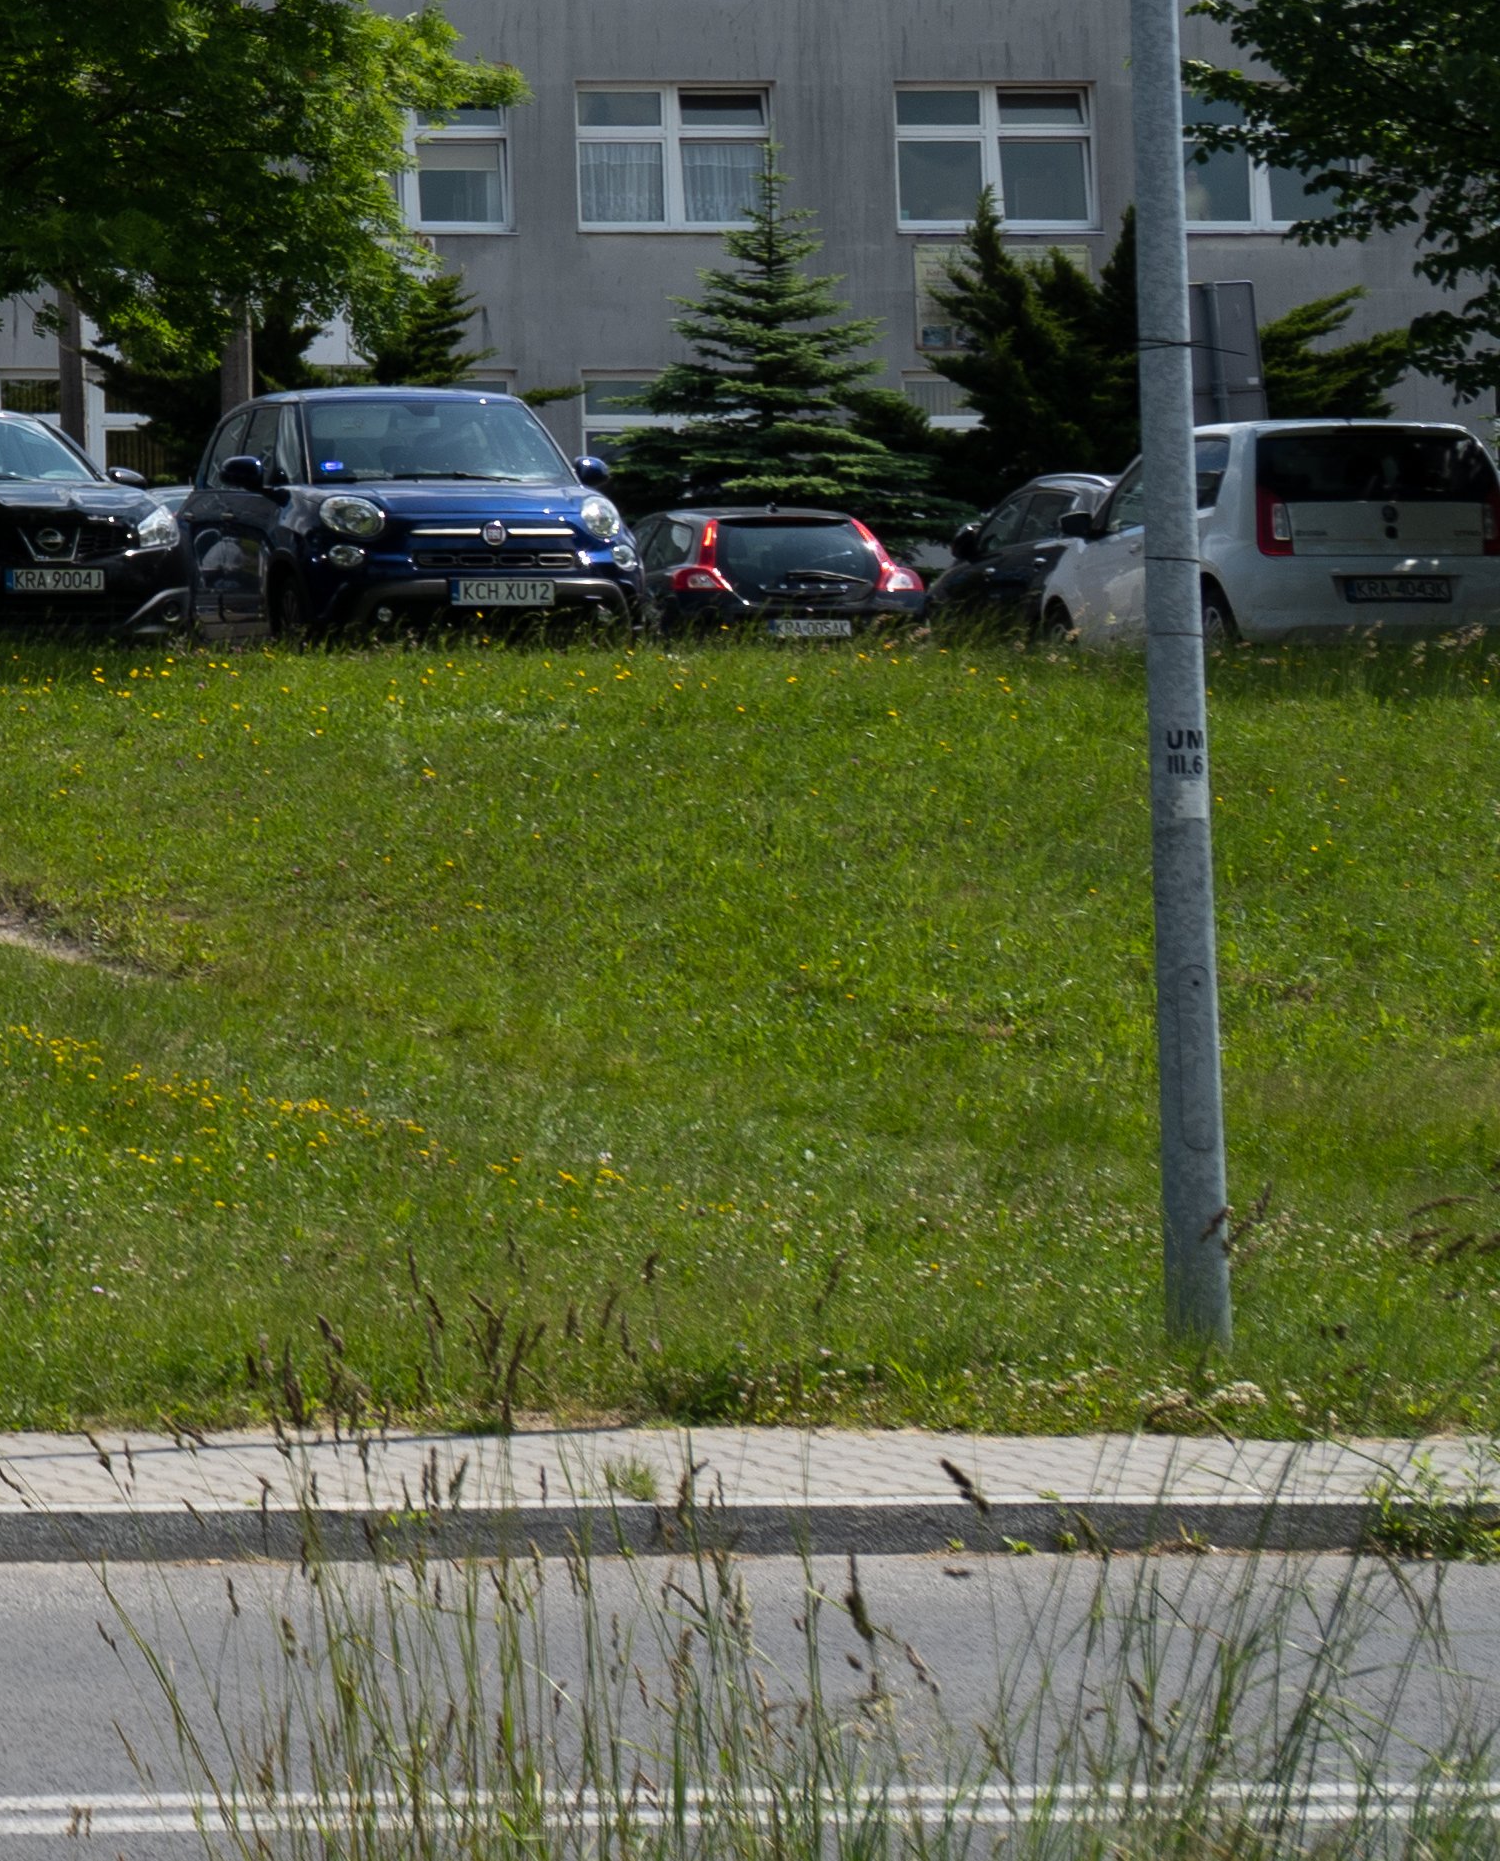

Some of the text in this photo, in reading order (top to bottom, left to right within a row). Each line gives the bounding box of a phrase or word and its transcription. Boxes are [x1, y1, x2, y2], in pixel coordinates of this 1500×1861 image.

[13, 571, 101, 589] KRA 9004J
[1356, 580, 1390, 597] KRA
[463, 583, 550, 600] KCH XU12
